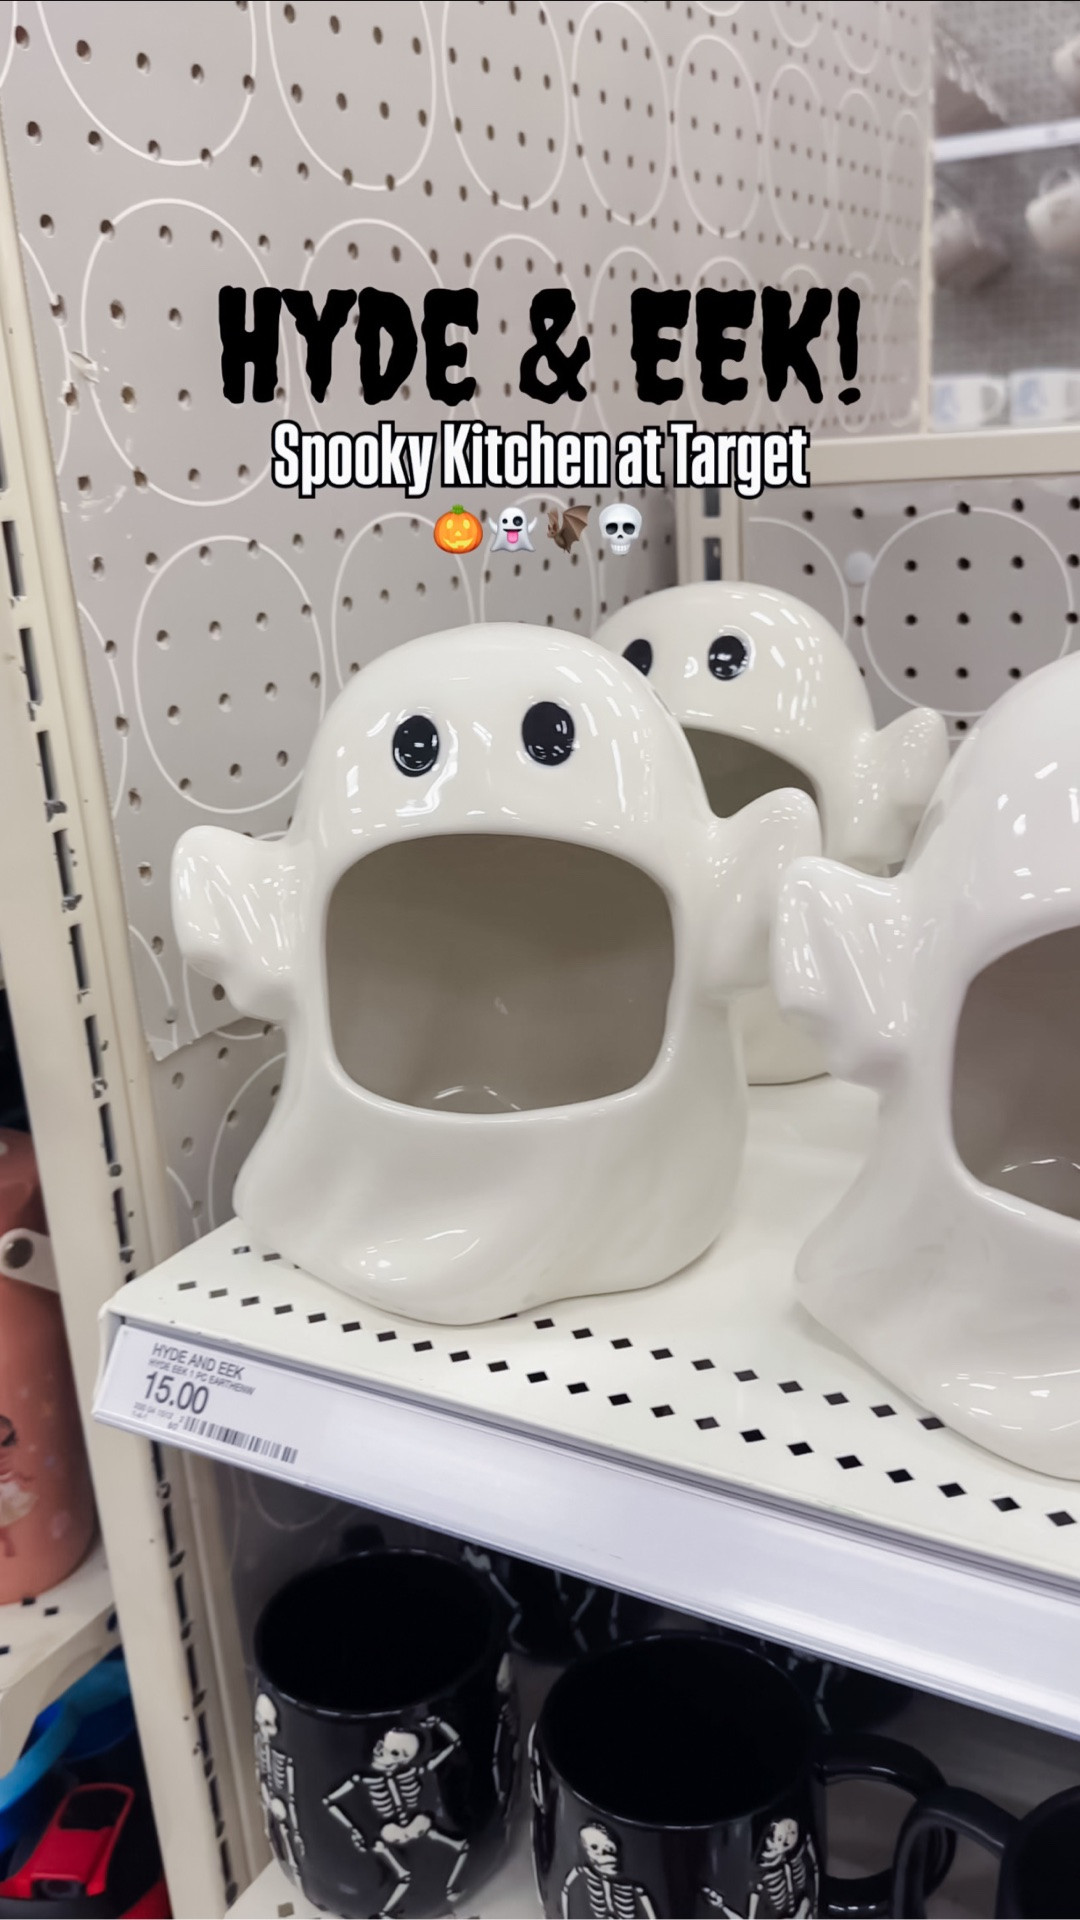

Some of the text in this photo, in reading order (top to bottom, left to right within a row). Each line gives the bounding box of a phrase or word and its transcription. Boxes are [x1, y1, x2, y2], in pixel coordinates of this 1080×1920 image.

[148, 1359, 171, 1371] HYDE
[172, 1364, 188, 1377] EEK
[152, 1343, 246, 1380] HYDE AND EEK
[145, 1371, 209, 1414] 15.00
